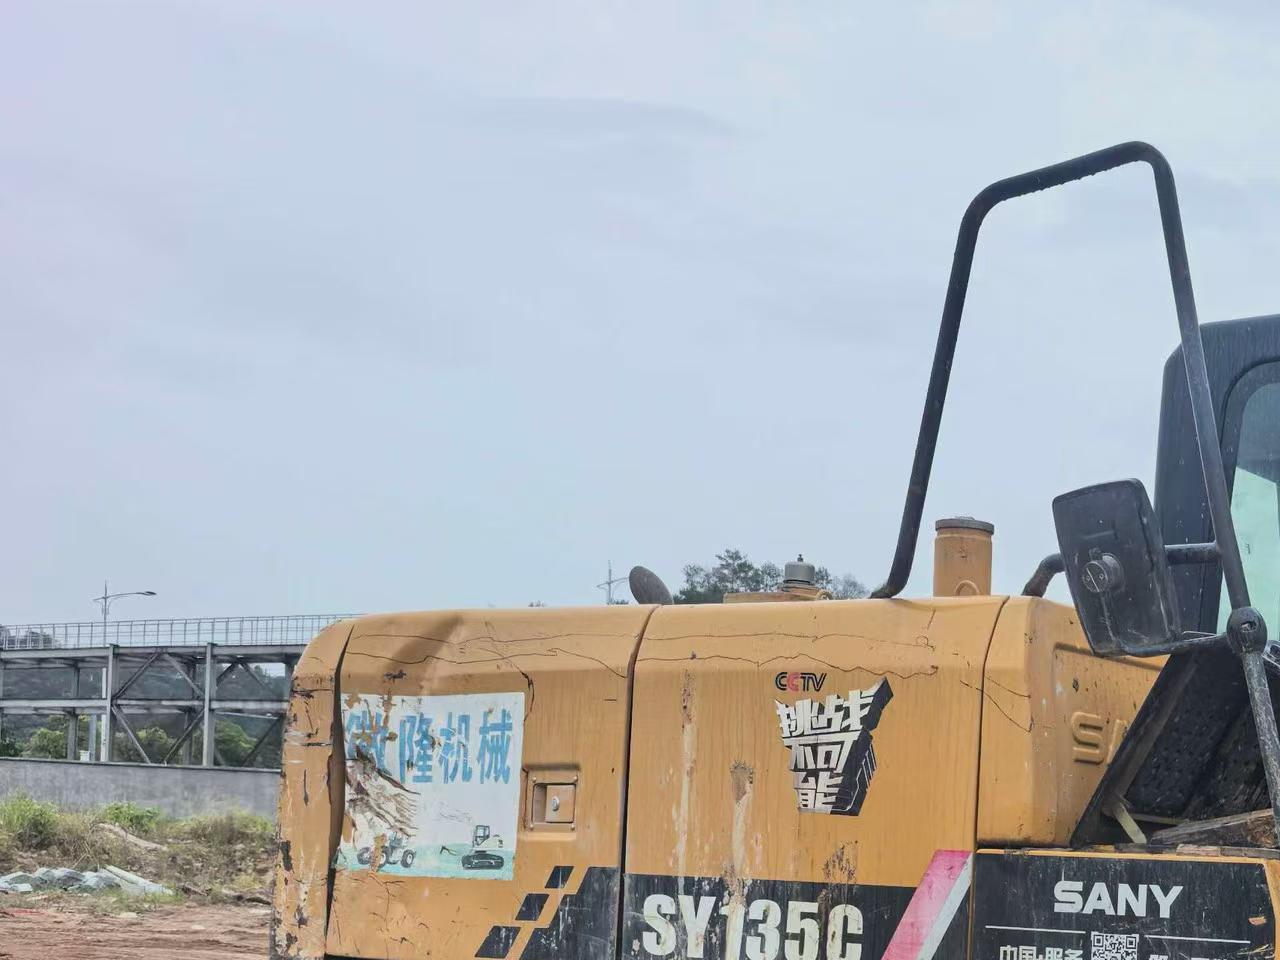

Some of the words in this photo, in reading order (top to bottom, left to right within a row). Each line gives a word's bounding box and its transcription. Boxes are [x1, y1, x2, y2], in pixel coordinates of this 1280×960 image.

[775, 671, 827, 692] CCTV
[775, 678, 888, 733] 挑战
[782, 730, 861, 769] 不可
[796, 771, 843, 813] 能
[1053, 880, 1184, 919] SANY
